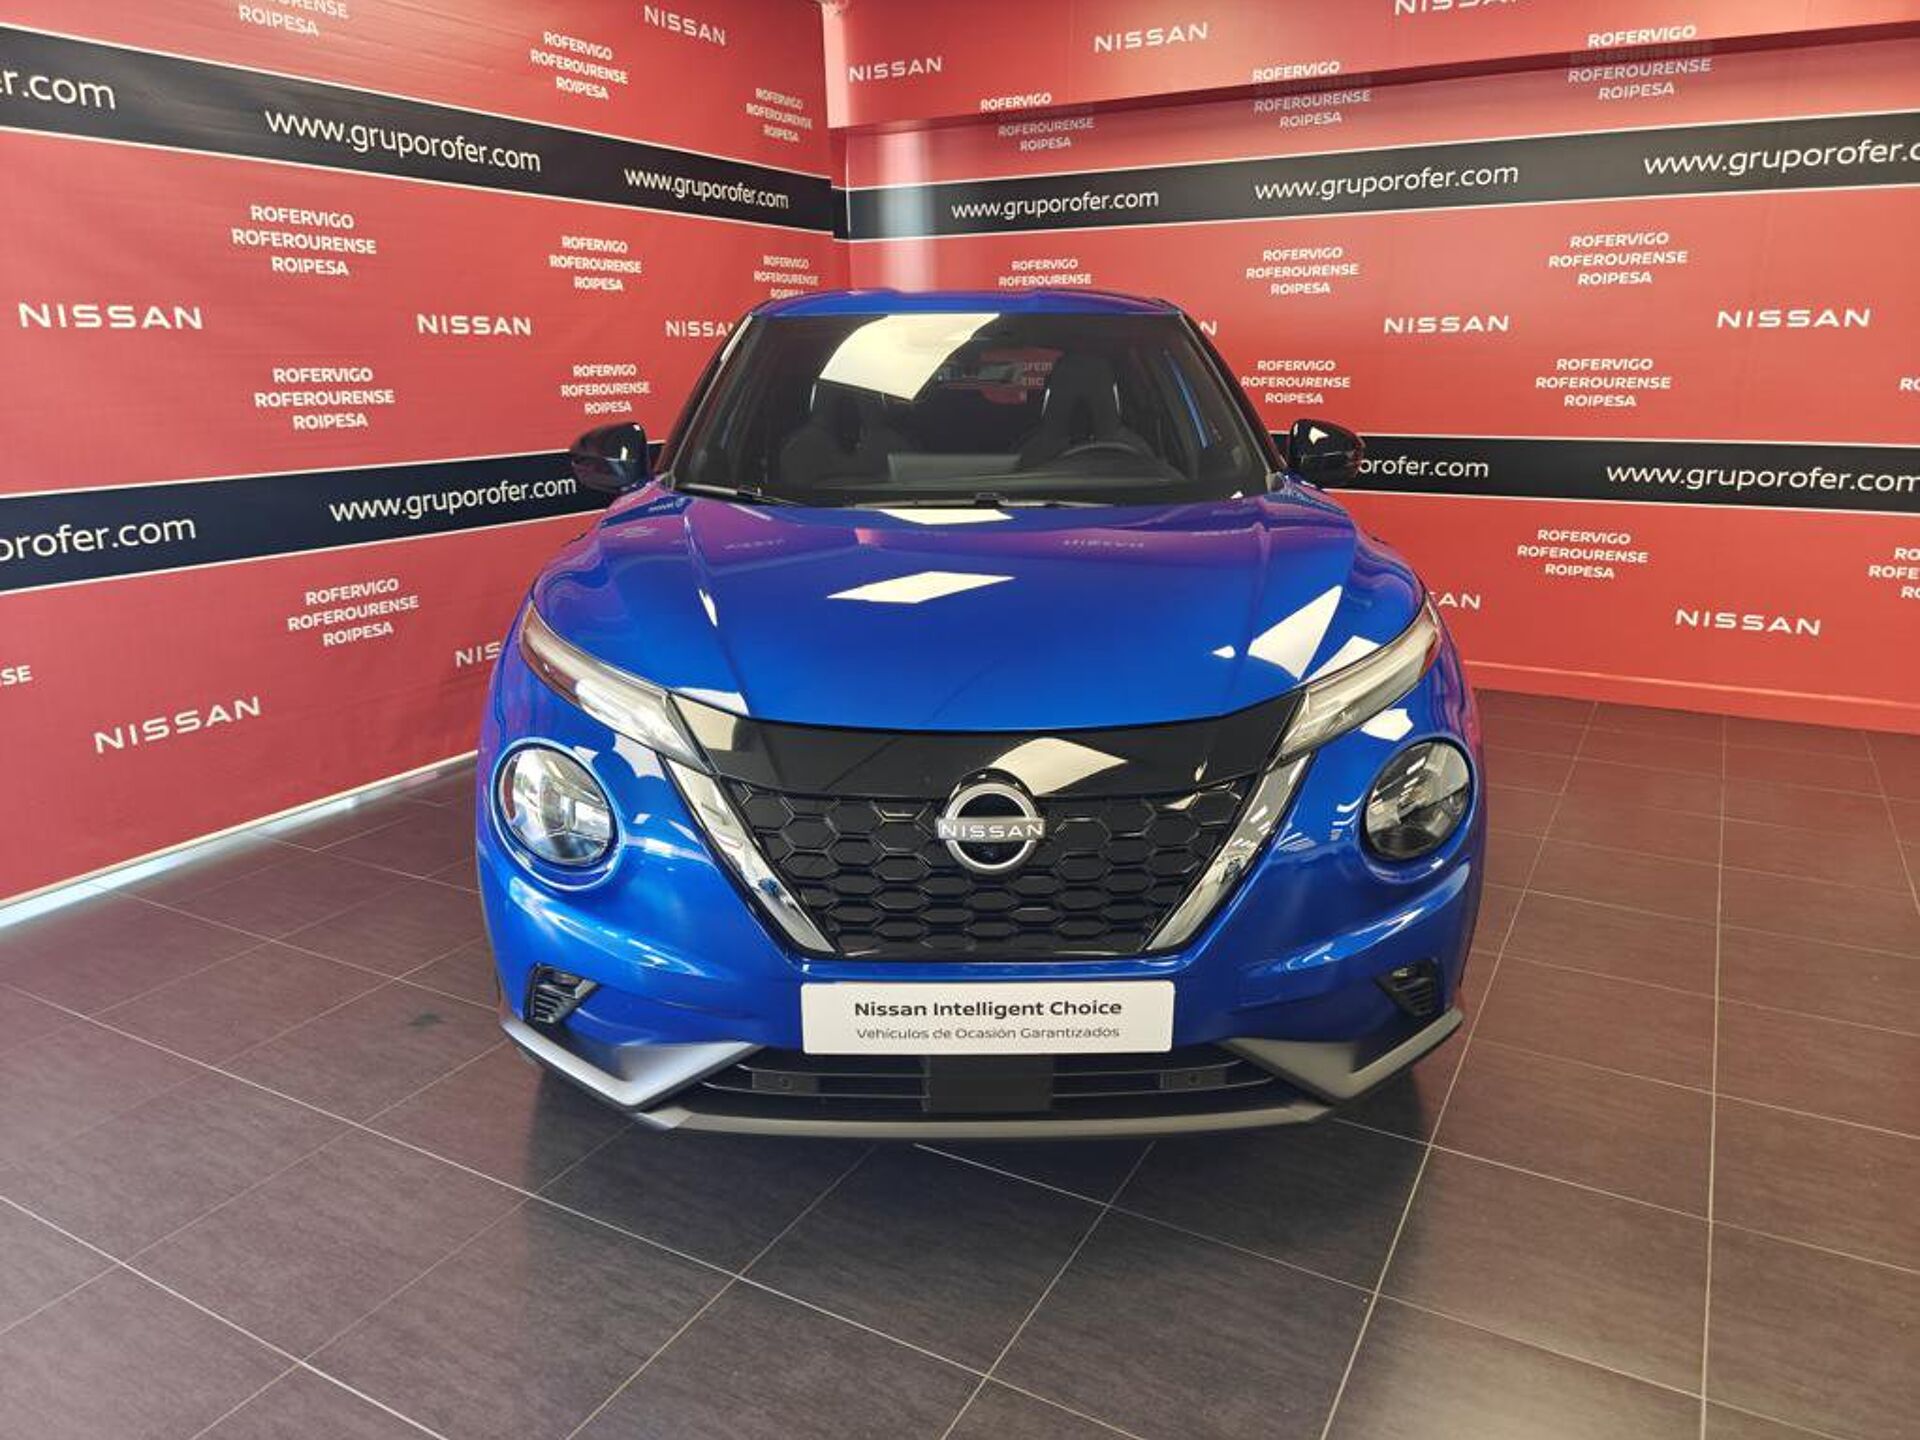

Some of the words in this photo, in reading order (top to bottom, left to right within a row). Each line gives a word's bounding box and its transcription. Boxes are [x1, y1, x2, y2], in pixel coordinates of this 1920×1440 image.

[239, 4, 320, 36] ROIPESA
[645, 5, 725, 45] NISSAN
[541, 31, 612, 61] ROFERVIGO
[1095, 22, 1208, 52] NISSAN
[1586, 24, 1699, 49] ROFERVIGO
[530, 48, 627, 85] ROFEROURENSE
[847, 57, 941, 83] NISSAN
[1251, 60, 1342, 83] ROFERVIGO
[1568, 58, 1713, 84] ROFEROURENSE
[0, 71, 115, 109] r.com
[556, 75, 610, 99] ROIPESA
[1597, 82, 1675, 101] ROIPESA
[980, 92, 1052, 112] ROFERVIGO
[1254, 89, 1372, 114] ROFEROURENSE
[265, 110, 541, 172] www.gruporofer.com
[624, 168, 789, 210] www.gruporofer.com
[1255, 167, 1518, 201] www.gruporofer.com
[951, 192, 1159, 220] www.gruporofer.com
[251, 205, 354, 228] ROFERVIGO
[232, 227, 376, 254] ROFEROURENSE
[561, 235, 629, 254] ROFERVIGO
[1569, 231, 1670, 249] ROFERVIGO
[1263, 246, 1344, 262] ROFERVIGO
[1548, 250, 1688, 268] ROFEROURENSE
[272, 256, 349, 275] ROIPESA
[549, 255, 641, 273] ROFEROURENSE
[1011, 258, 1079, 271] ROFERVIGO
[1246, 263, 1359, 279] ROFEROURENSE
[573, 275, 624, 291] ROIPESA
[998, 273, 1092, 287] ROFEROURENSE
[1270, 281, 1331, 295] ROIPESA
[1577, 271, 1652, 286] ROIPESA
[19, 303, 201, 329] NISSAN
[417, 314, 531, 335] NISSAN
[1385, 315, 1508, 333] NISSAN
[1718, 309, 1870, 327] NISSAN
[665, 320, 734, 337] NISSA
[572, 363, 637, 377] ROFERVIGO
[1257, 359, 1336, 372] ROFERVIGO
[1556, 358, 1654, 371] ROFERVIGO
[272, 367, 374, 383] ROFERVIGO
[1240, 375, 1351, 388] ROFEROURENSE
[1535, 376, 1672, 390] ROFEROURENSE
[253, 389, 395, 408] ROFEROURENSE
[560, 381, 650, 397] ROFEROURENSE
[1264, 392, 1324, 405] ROIPESA
[584, 400, 633, 415] ROIPESA
[1563, 394, 1637, 407] ROIPESA
[292, 412, 369, 430] ROIPESA
[329, 473, 577, 524] www.gruporofer.com
[1537, 529, 1632, 546] ROFERVIGO
[1518, 543, 1648, 563] ROFEROURENSE
[1544, 563, 1615, 579] ROIPESA
[305, 578, 401, 607] ROFERVIGO
[288, 594, 419, 633] ROFEROURENSE
[1676, 610, 1820, 635] NISSAN
[323, 621, 393, 646] ROIPESA
[94, 697, 259, 753] NISSAN
[939, 821, 1043, 839] NISSAN
[854, 1001, 927, 1017] Nissan
[933, 1001, 1044, 1020] Intelligent
[1049, 999, 1122, 1016] Choice
[932, 1027, 952, 1040] de
[1019, 1026, 1120, 1039] Garantizados
